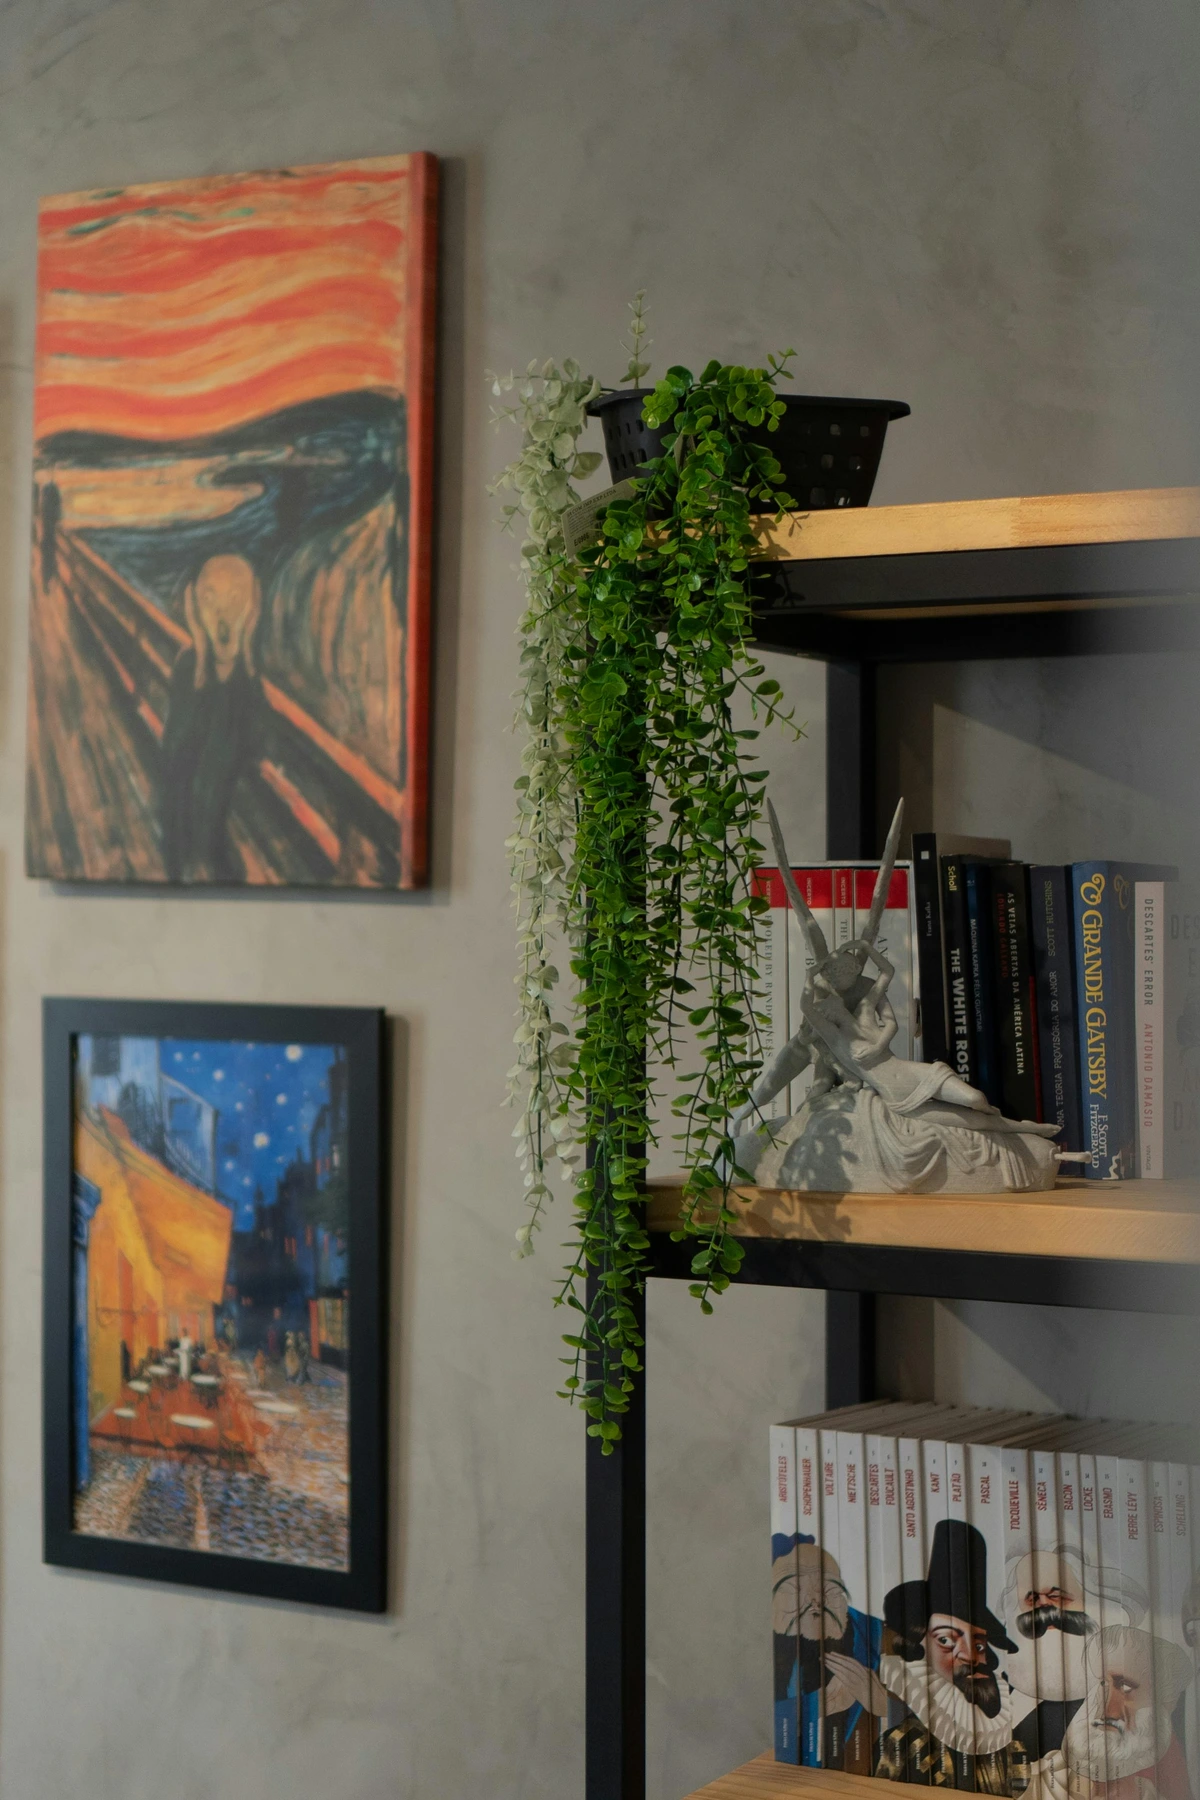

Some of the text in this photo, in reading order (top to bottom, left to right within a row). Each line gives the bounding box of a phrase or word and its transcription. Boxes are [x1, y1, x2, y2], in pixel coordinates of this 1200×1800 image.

[948, 865, 957, 892] Scholl
[839, 918, 849, 941] THE
[924, 901, 932, 919] Kafka
[1045, 880, 1056, 957] SCOTT HUTCHINS
[765, 963, 774, 977] BY
[1082, 909, 1104, 1004] GRANDE
[1143, 897, 1155, 1006] DESCARTES' ERROR
[970, 918, 983, 1032] MÁQUINA KAFKA FÉLIX GUATTARI
[1007, 892, 1025, 1075] AS VEIAS ABERTAS DA AMÉRICA LATINA
[950, 948, 970, 1082] THE WHITE ROSE
[1049, 970, 1065, 1129] UMA TEORIA PROVISÓRIA DO AMOR
[1085, 1007, 1108, 1100] GATSBY
[1143, 1023, 1155, 1128] ANTONIO DAMASIO
[778, 1455, 788, 1502] ARISTÓTELES
[803, 1458, 813, 1515] SCHOPENHAUER
[825, 1461, 834, 1496] VOLTAIRE
[848, 1463, 857, 1503] NIETZSCHE
[870, 1463, 880, 1505] DESCARTES
[885, 1467, 896, 1505] FOUCAULT
[931, 1472, 940, 1493] KANT
[952, 1472, 962, 1502] PLATÃO
[980, 1475, 991, 1504] PASCAL
[1036, 1481, 1047, 1511] SÊNECA
[1064, 1484, 1074, 1510] BACON
[905, 1469, 916, 1537] SANTO AGOSTINHO
[1009, 1479, 1021, 1530] TOCQUEVILLE
[1084, 1487, 1094, 1511] LOCKE
[1103, 1487, 1114, 1519] ERASMO
[1126, 1491, 1138, 1512] LÉVY
[1153, 1495, 1164, 1532] ESPINOSA
[1176, 1494, 1187, 1536] SCHELLING
[1128, 1513, 1139, 1540] PIERRE
